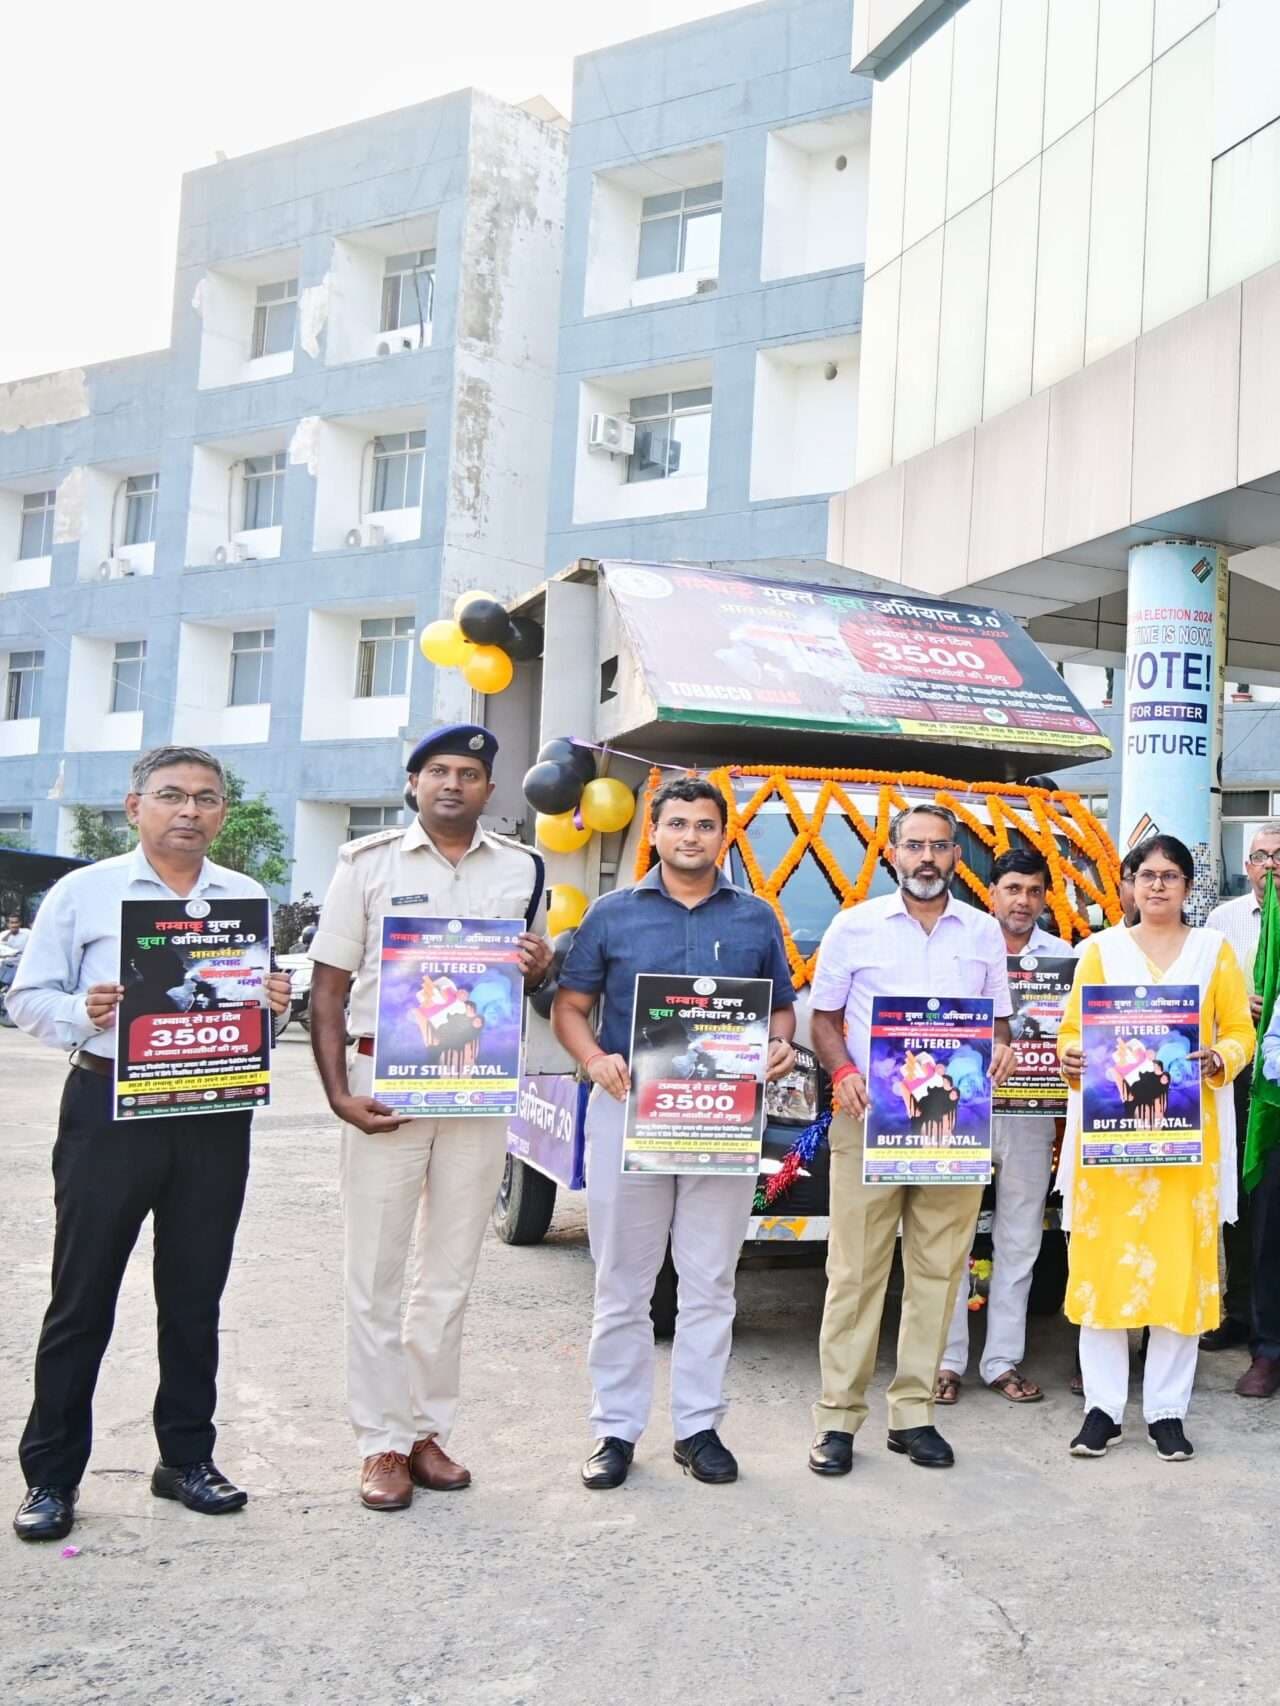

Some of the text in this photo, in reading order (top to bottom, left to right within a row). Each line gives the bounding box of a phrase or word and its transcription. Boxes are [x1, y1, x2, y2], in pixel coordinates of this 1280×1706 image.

[874, 601, 961, 623] अभियान
[967, 614, 1001, 628] 3.0
[1144, 608, 1213, 624] ELECTION 2024
[1162, 625, 1175, 644] IS
[872, 642, 985, 670] 3500
[1127, 652, 1212, 692] VOTE!
[666, 681, 752, 700] TOBACCO
[1131, 705, 1203, 719] FOR BETTER
[1127, 735, 1207, 756] FUTURE
[156, 920, 241, 932] तम्बाकू मुक्त
[137, 933, 256, 949] युवा अभियान 3.0
[421, 962, 487, 974] FILTERED
[1055, 983, 1071, 991] 3.0
[712, 997, 743, 1009] मुक्त
[678, 1007, 730, 1020] अभियान
[736, 1011, 756, 1021] 3.0
[150, 1026, 240, 1047] 3500
[1114, 1025, 1169, 1035] FILTERED
[904, 1039, 961, 1049] FILTERED
[1014, 1052, 1055, 1065] 500
[388, 1065, 509, 1076] BUT STILL FATAL.
[655, 1094, 734, 1111] 3500
[519, 1082, 572, 1142] अभियान 3.0
[1093, 1118, 1192, 1129] BUT STILL FATAL.
[877, 1135, 982, 1146] BUT STILL FATAL.
